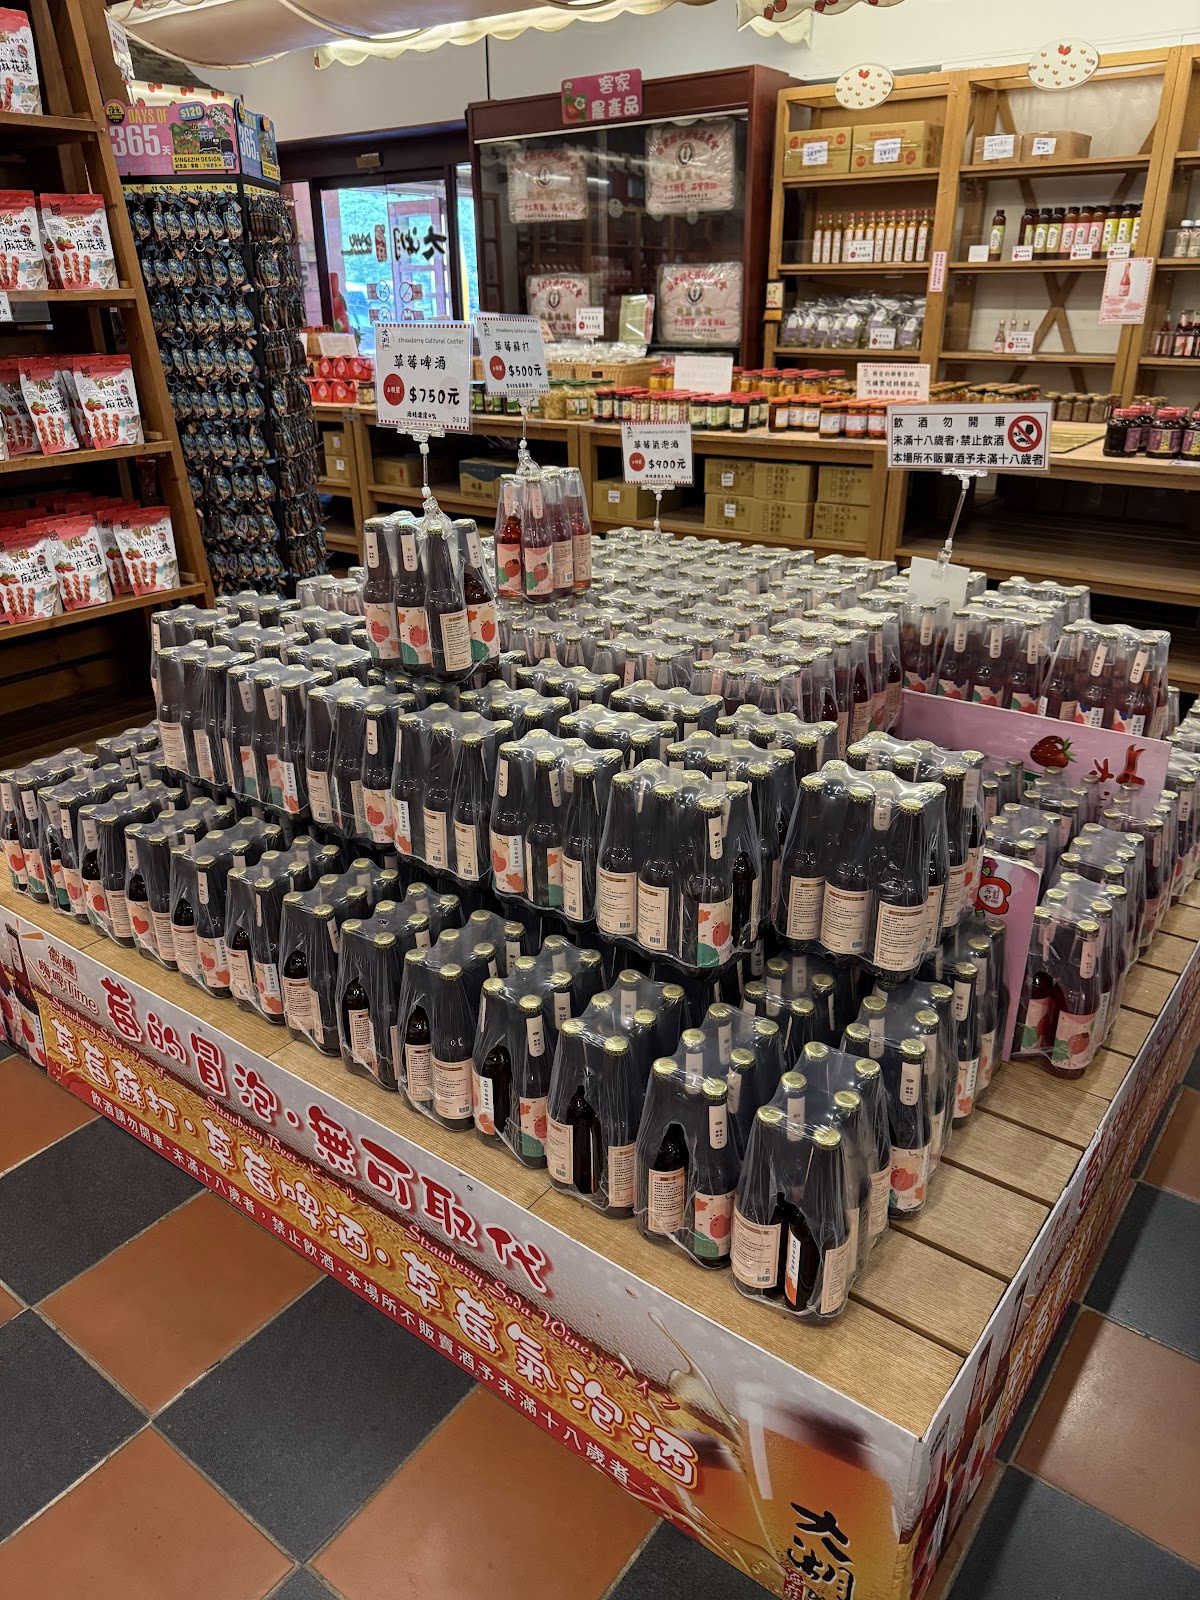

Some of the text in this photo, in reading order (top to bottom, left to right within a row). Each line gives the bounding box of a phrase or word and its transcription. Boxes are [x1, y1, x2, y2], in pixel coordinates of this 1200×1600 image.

[598, 73, 631, 95] 客家
[128, 109, 154, 123] DAYS
[157, 109, 167, 123] OF
[180, 106, 202, 118] $120
[591, 95, 639, 120] 農產品
[110, 125, 171, 156] 365天
[494, 340, 529, 352] 草莓蘇打
[394, 353, 446, 370] 草莓啤酒
[509, 364, 542, 378] $500元
[409, 386, 460, 405] $750元
[893, 416, 1006, 428] 飲酒勿開車
[634, 440, 679, 450] 草莓氣泡酒
[648, 458, 686, 469] $900元
[893, 453, 1044, 466] 本場所不販賣酒予未滿十八歲者
[48, 945, 76, 978] 微醺
[51, 996, 122, 1051] Strawberry Soda
[204, 1095, 298, 1164] Strawberry Beer
[405, 1224, 590, 1354] Strawberry Soda Wine
